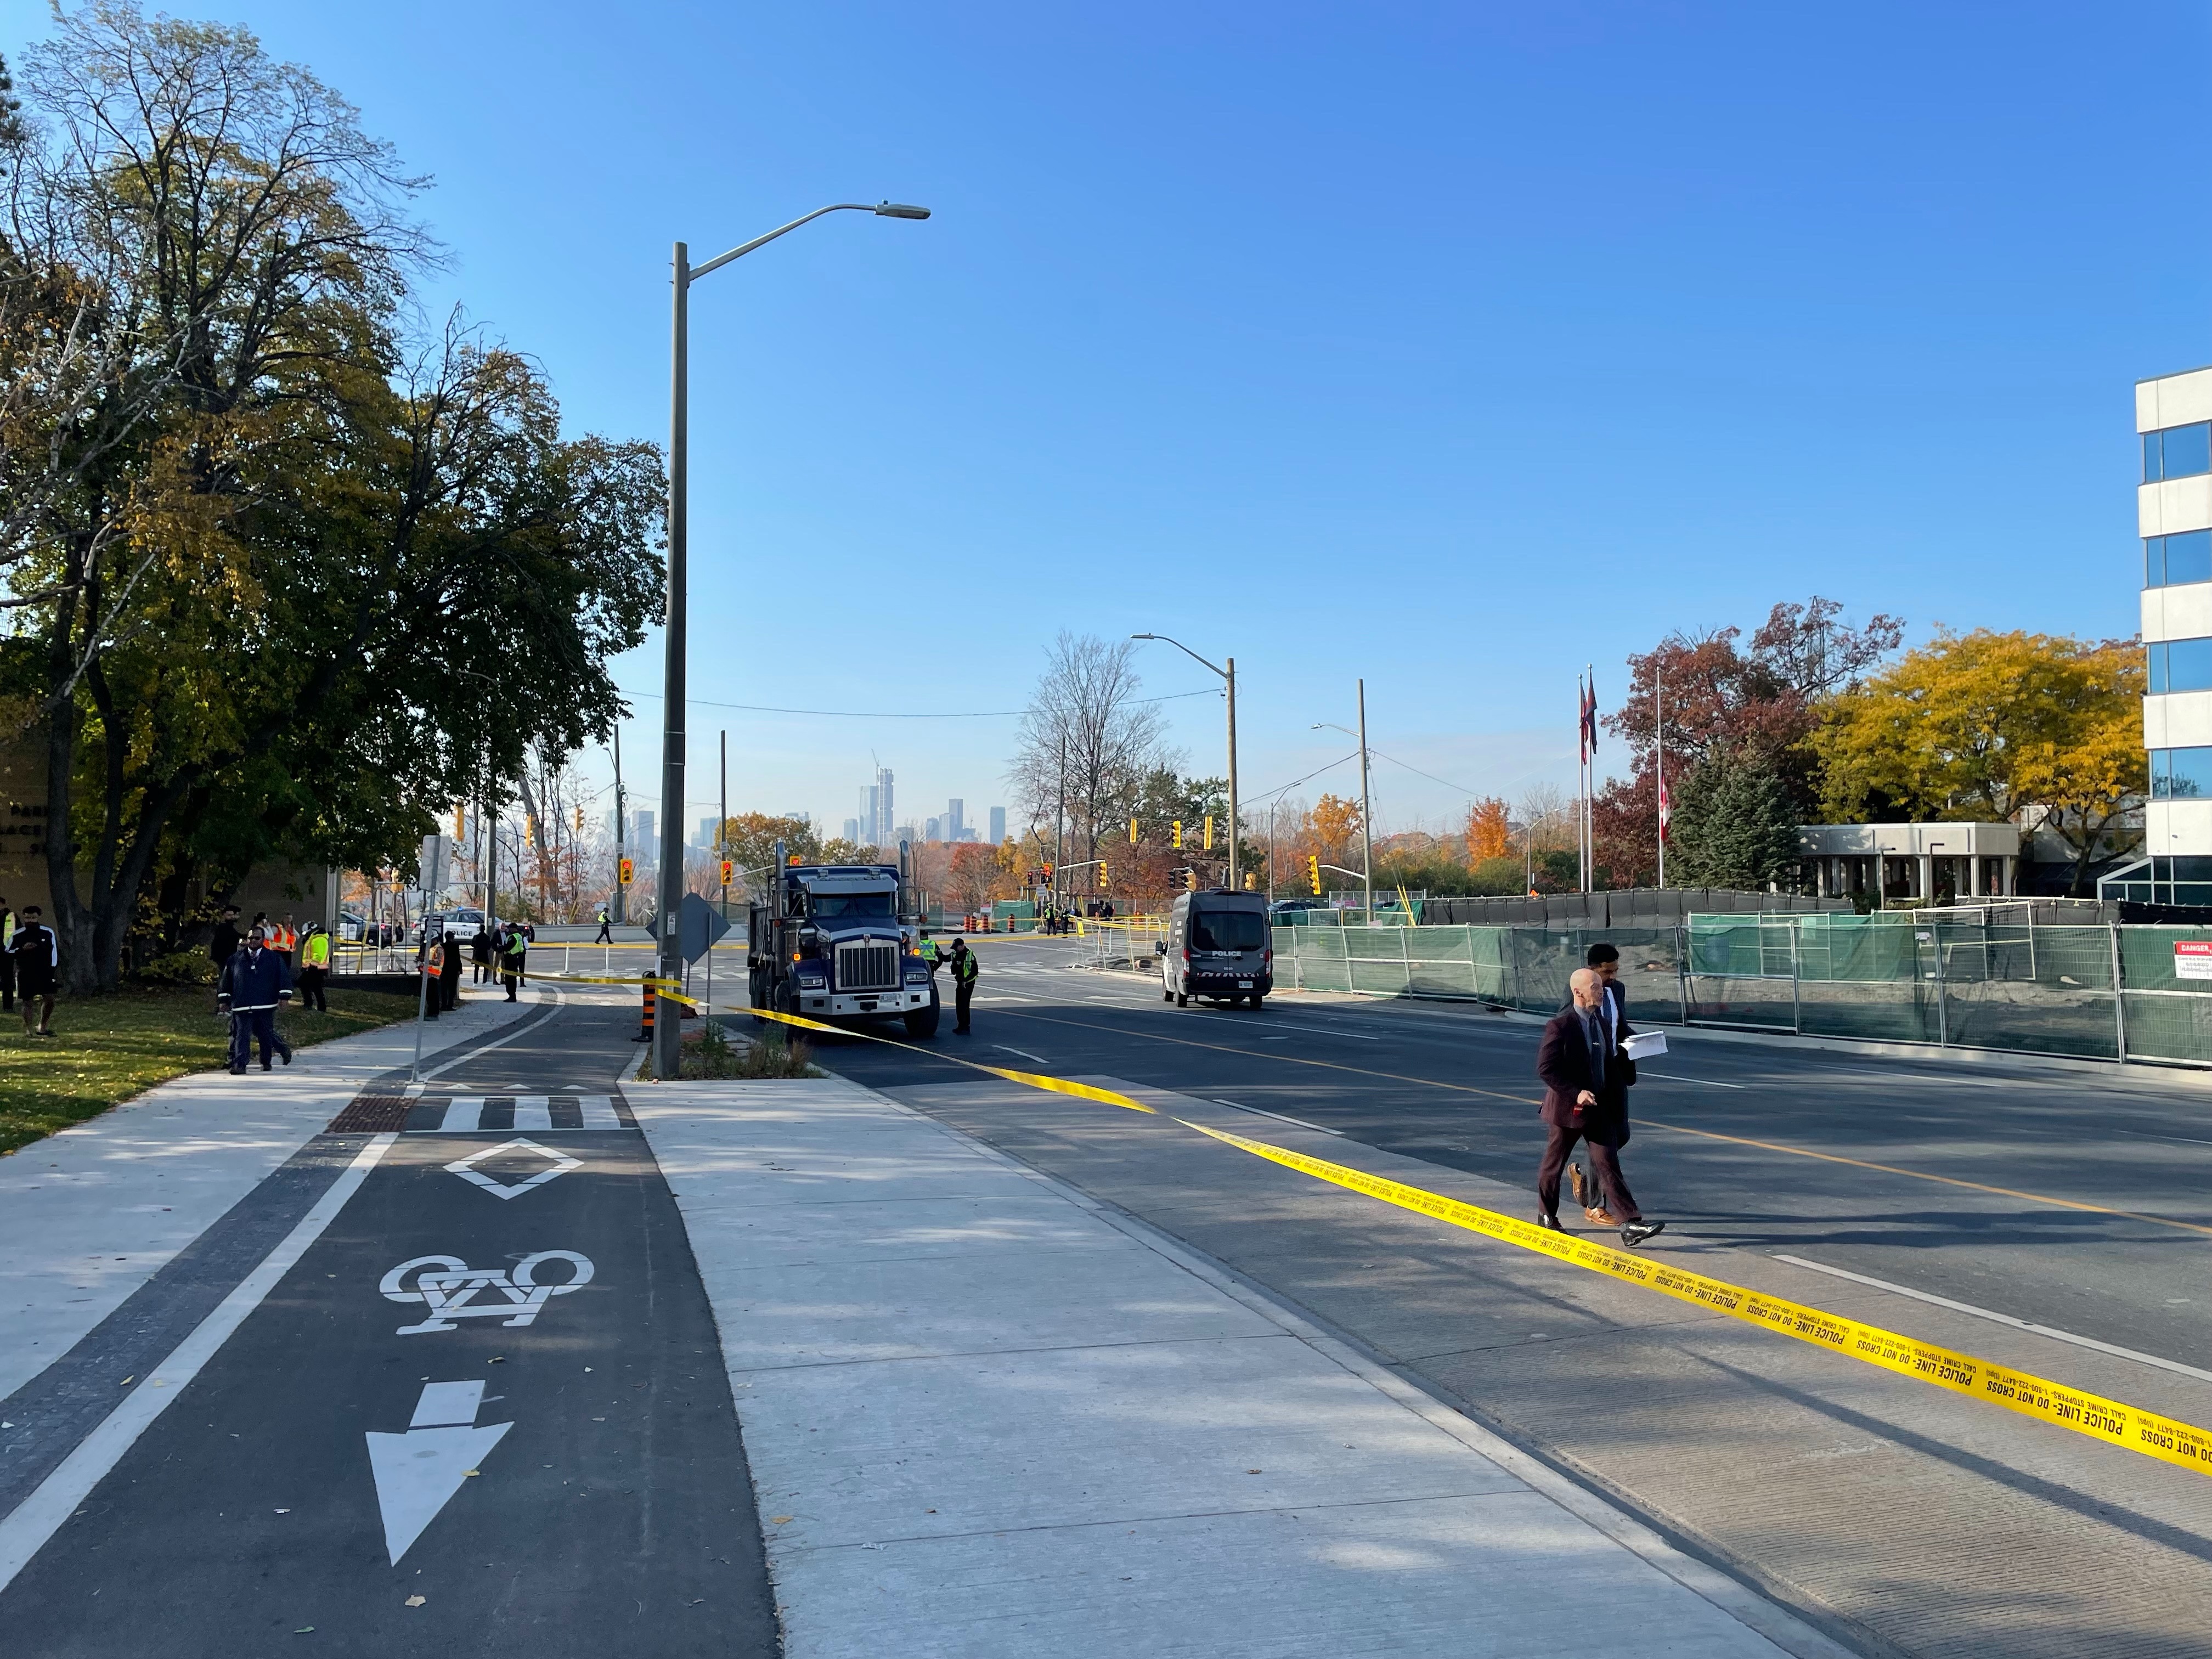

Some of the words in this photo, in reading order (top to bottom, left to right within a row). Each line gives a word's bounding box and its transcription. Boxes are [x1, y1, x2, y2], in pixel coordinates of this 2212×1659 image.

[1577, 1250, 1593, 1261] CROSS
[1592, 1256, 1603, 1264] NOT
[1602, 1259, 1610, 1267] DO
[1611, 1262, 1626, 1273] LINE-
[1624, 1266, 1647, 1280] POLICE
[1654, 1276, 1673, 1287] CROSS
[1672, 1281, 1685, 1291] NOT
[1684, 1285, 1694, 1294] DO
[1695, 1289, 1712, 1301] LINE-
[1711, 1294, 1737, 1310] POLICE
[1746, 1305, 1768, 1317] CROSS
[1768, 1312, 1782, 1322] NOT
[1782, 1316, 1792, 1325] DO
[1796, 1312, 1820, 1324] STOPPERS-
[1821, 1319, 1837, 1330] CRIME
[1794, 1321, 1815, 1335] LINE-
[1838, 1325, 1850, 1334] CALL
[1814, 1327, 1845, 1345] POLICE
[1857, 1340, 1881, 1355] CROSS
[1881, 1348, 1898, 1360] NOT
[1899, 1353, 1910, 1364] DO
[1913, 1348, 1941, 1363] STOPPERS-
[1912, 1358, 1937, 1374] LINE-
[1943, 1357, 1961, 1369] CRIME
[1963, 1362, 1976, 1374] CALL
[1938, 1365, 1972, 1386] POLICE
[1987, 1381, 2015, 1398] CROSS
[2002, 1375, 2048, 1395] 1-800-222-8477
[2016, 1390, 2034, 1404] NOT
[2037, 1397, 2050, 1409] DO
[2051, 1391, 2085, 1408] STOPPERS-
[2053, 1403, 2080, 1421] LINE-
[2087, 1402, 2108, 1415] CRIME
[2110, 1408, 2126, 1421] CALL
[2083, 1411, 2123, 1435] POLICE
[2141, 1429, 2173, 1449] CROSS
[2158, 1424, 2211, 1447] 1-800-222-8477
[2176, 1441, 2196, 1458] NOT
[2201, 1449, 2212, 1464] DO
